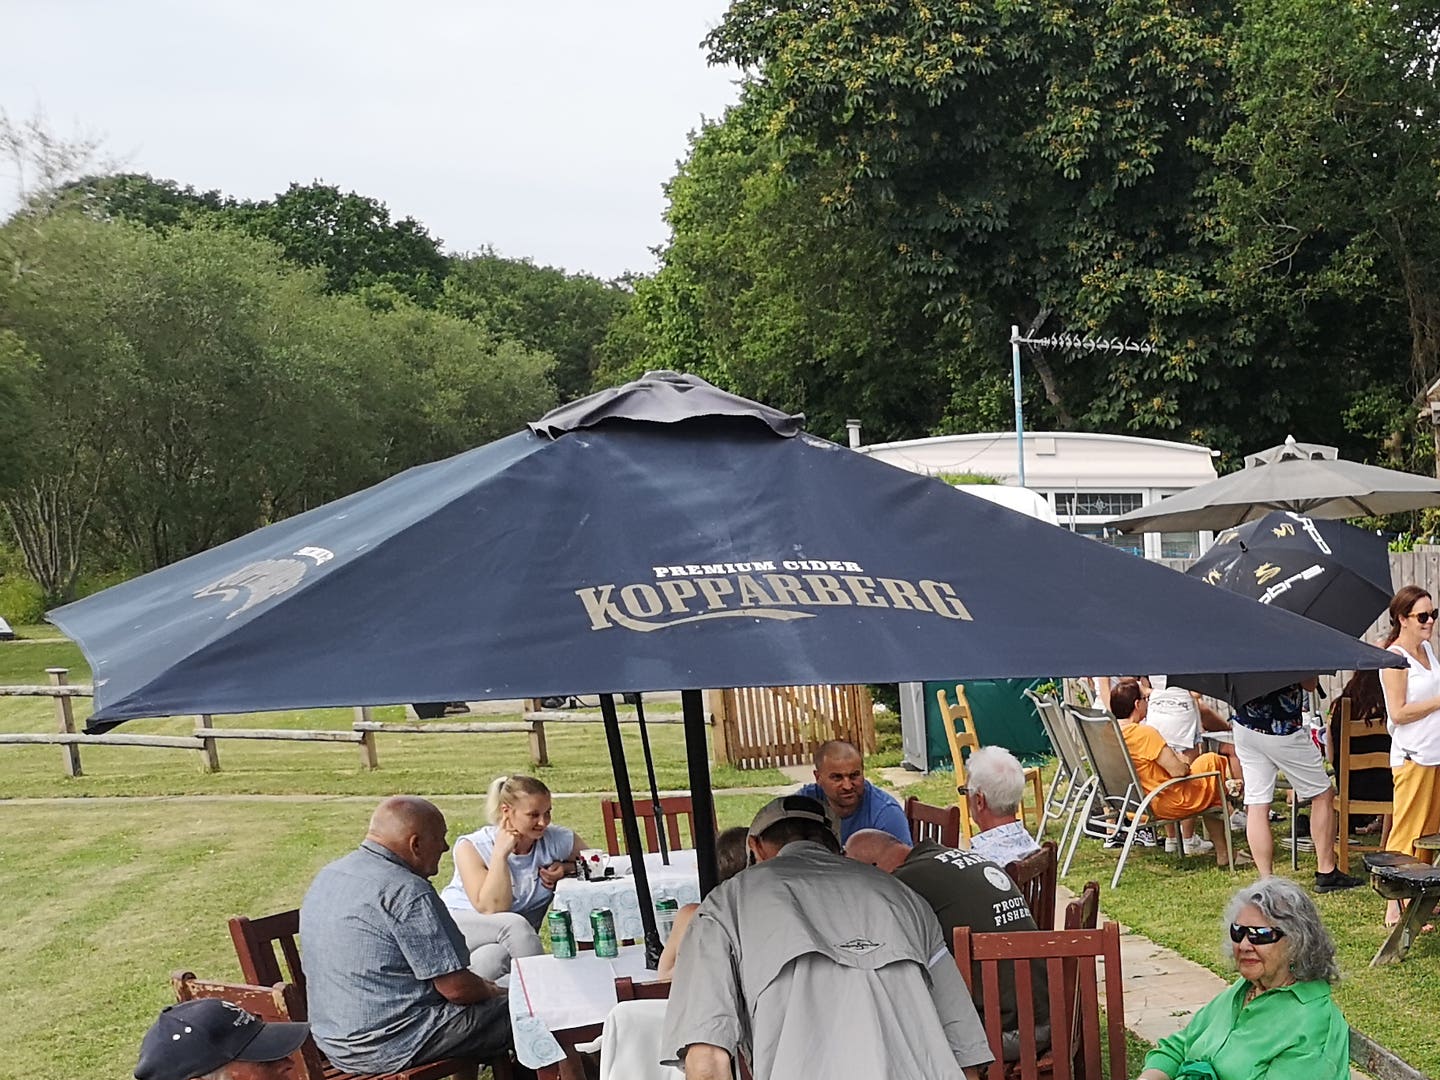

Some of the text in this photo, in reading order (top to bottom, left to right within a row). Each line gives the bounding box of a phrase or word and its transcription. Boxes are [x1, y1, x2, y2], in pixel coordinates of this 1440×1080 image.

[653, 560, 864, 578] PREMIUM CIDER
[574, 574, 974, 633] KOPPARBERG
